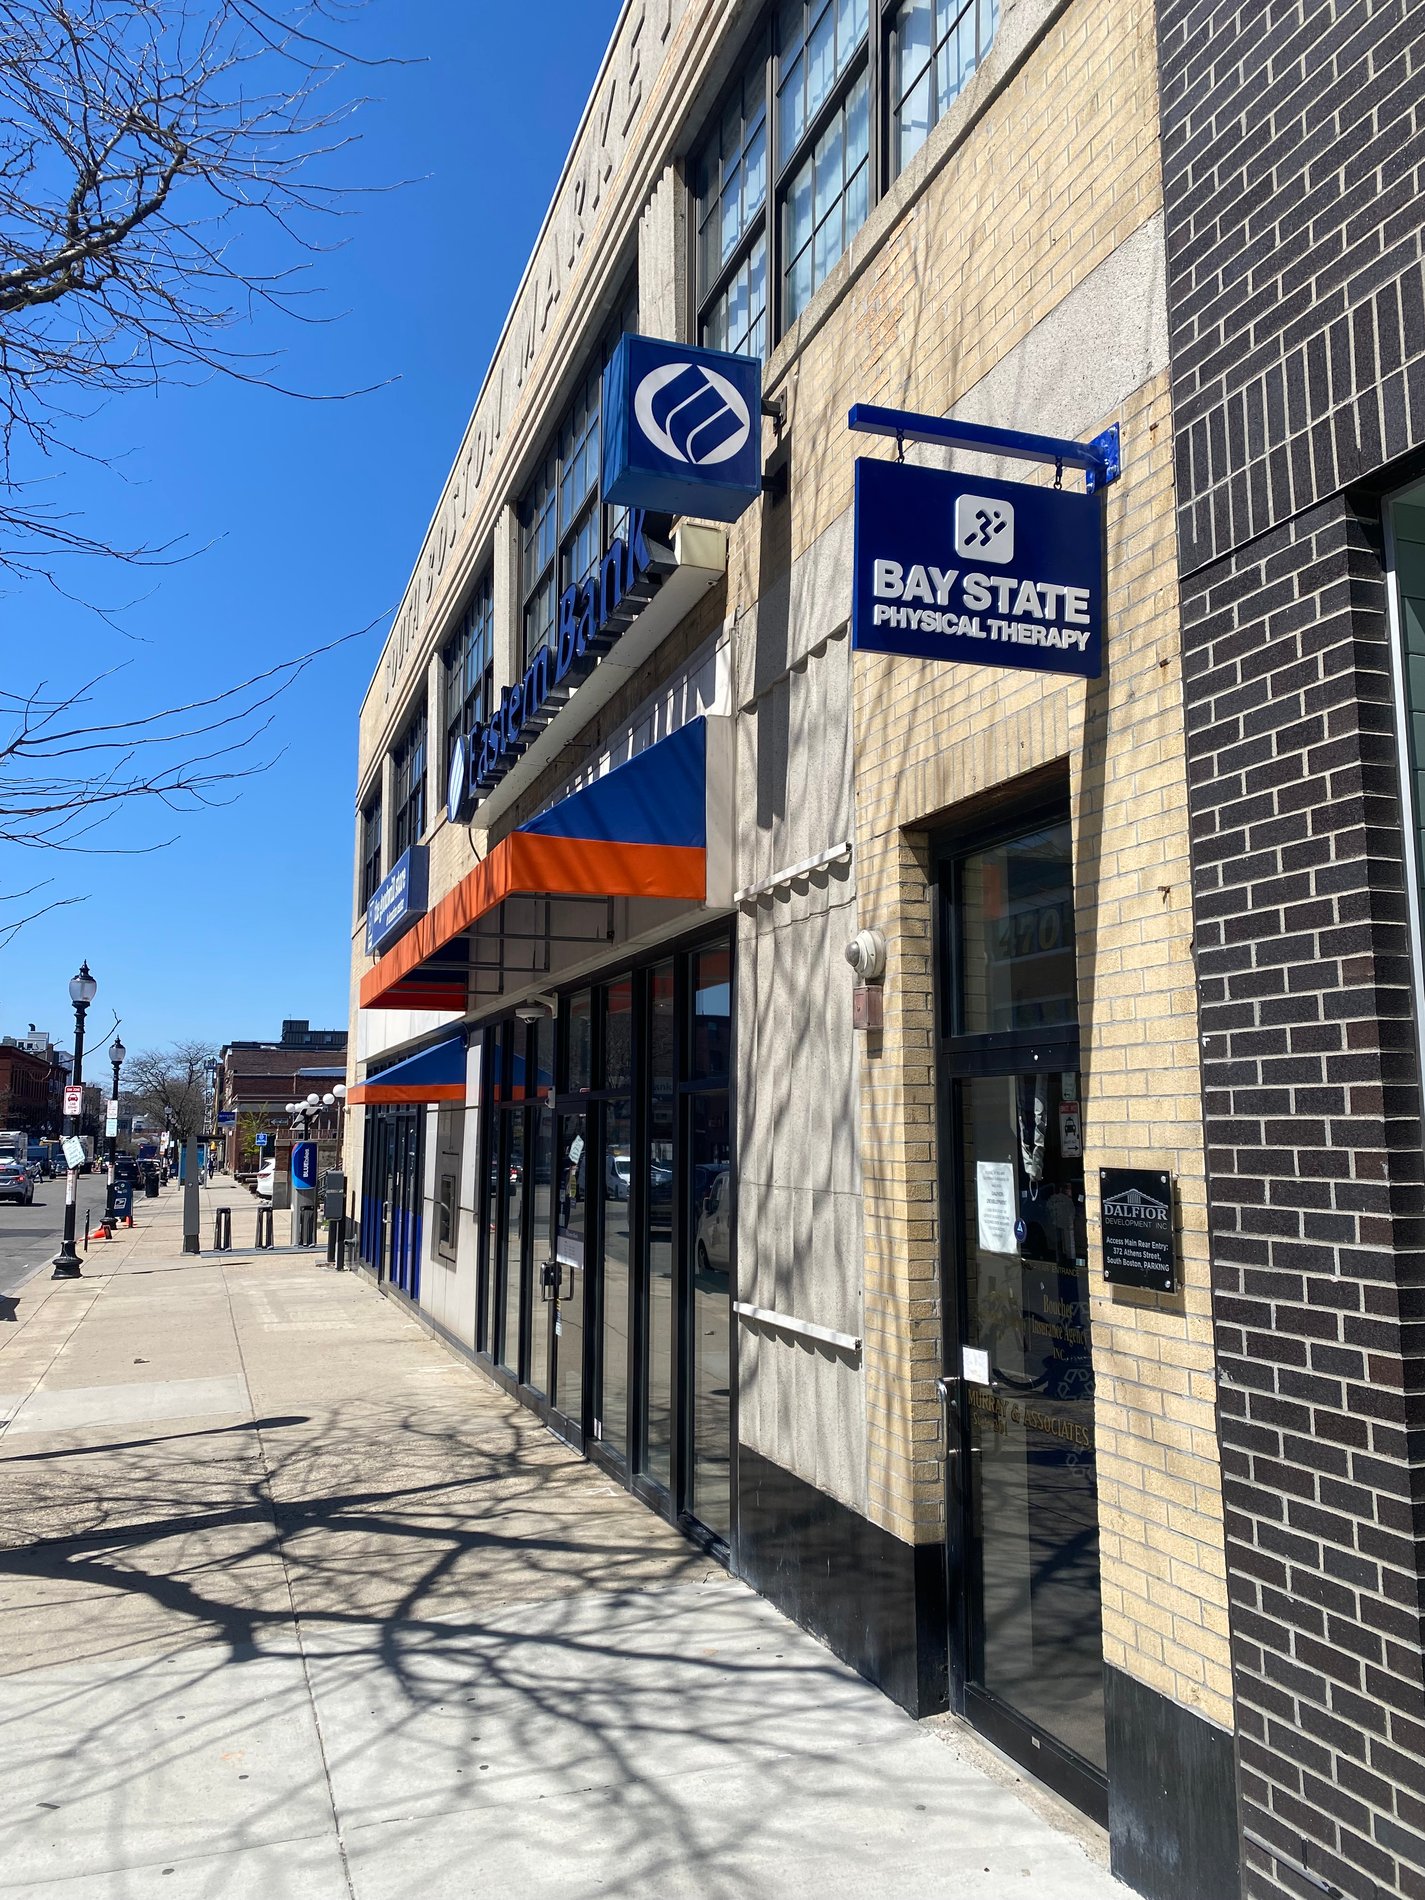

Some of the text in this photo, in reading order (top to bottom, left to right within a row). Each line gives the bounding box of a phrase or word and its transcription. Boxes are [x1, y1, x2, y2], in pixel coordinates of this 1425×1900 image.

[874, 559, 1090, 625] BAY STATE
[873, 604, 1090, 652] PHYSICAL THERAPY
[468, 644, 556, 800] Eastern
[1104, 1205, 1168, 1220] DALFIOR
[1105, 1217, 1167, 1230] DEVELOPMENT INC
[1106, 1236, 1169, 1252] Access Main Rear Entry:
[1113, 1247, 1162, 1261] 372 Athens Street,
[1052, 1265, 1080, 1277] ENTRANCE
[1107, 1256, 1170, 1272] South Boston, PARKING
[1043, 1295, 1073, 1319] Boucher
[1032, 1315, 1087, 1348] Insurance Agency
[968, 1389, 1009, 1417] MURRAY
[1011, 1404, 1021, 1424] &
